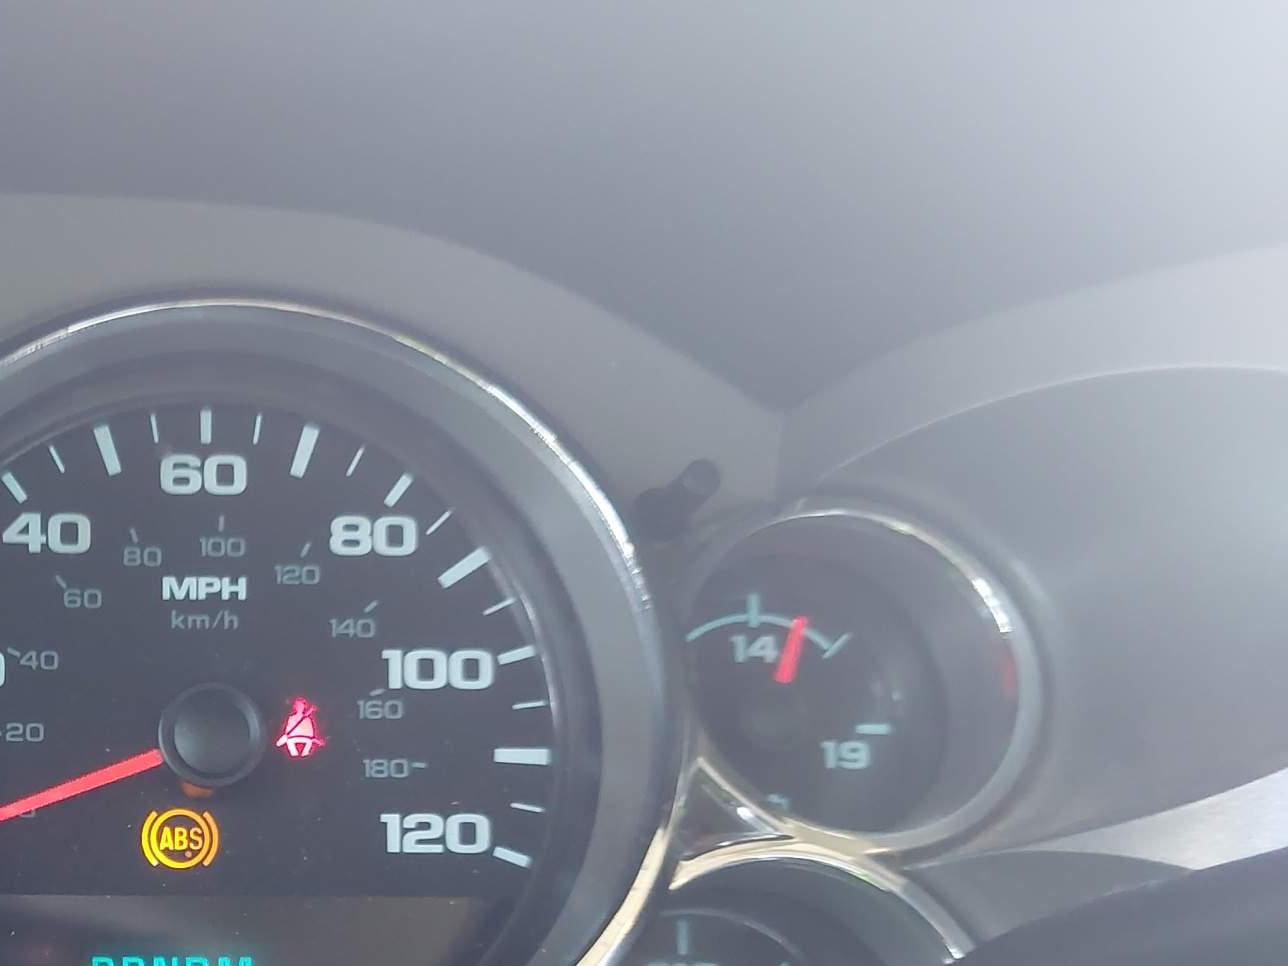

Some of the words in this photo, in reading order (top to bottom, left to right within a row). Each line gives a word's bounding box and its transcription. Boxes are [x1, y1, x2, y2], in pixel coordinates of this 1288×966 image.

[160, 454, 247, 495] 60
[2, 512, 92, 554] 40
[329, 515, 418, 557] 80
[123, 547, 162, 567] 80
[200, 537, 247, 558] 100
[275, 565, 321, 585] 120
[64, 588, 103, 609] 60
[162, 576, 248, 601] MPH
[171, 610, 239, 630] km/h
[329, 618, 376, 638] 140
[20, 650, 59, 671] 40
[382, 649, 496, 690] 100
[357, 699, 404, 720] 160
[6, 722, 45, 742] 20
[822, 740, 872, 770] 19
[363, 758, 410, 779] 180
[159, 826, 203, 851] ABS
[380, 813, 491, 854] 120
